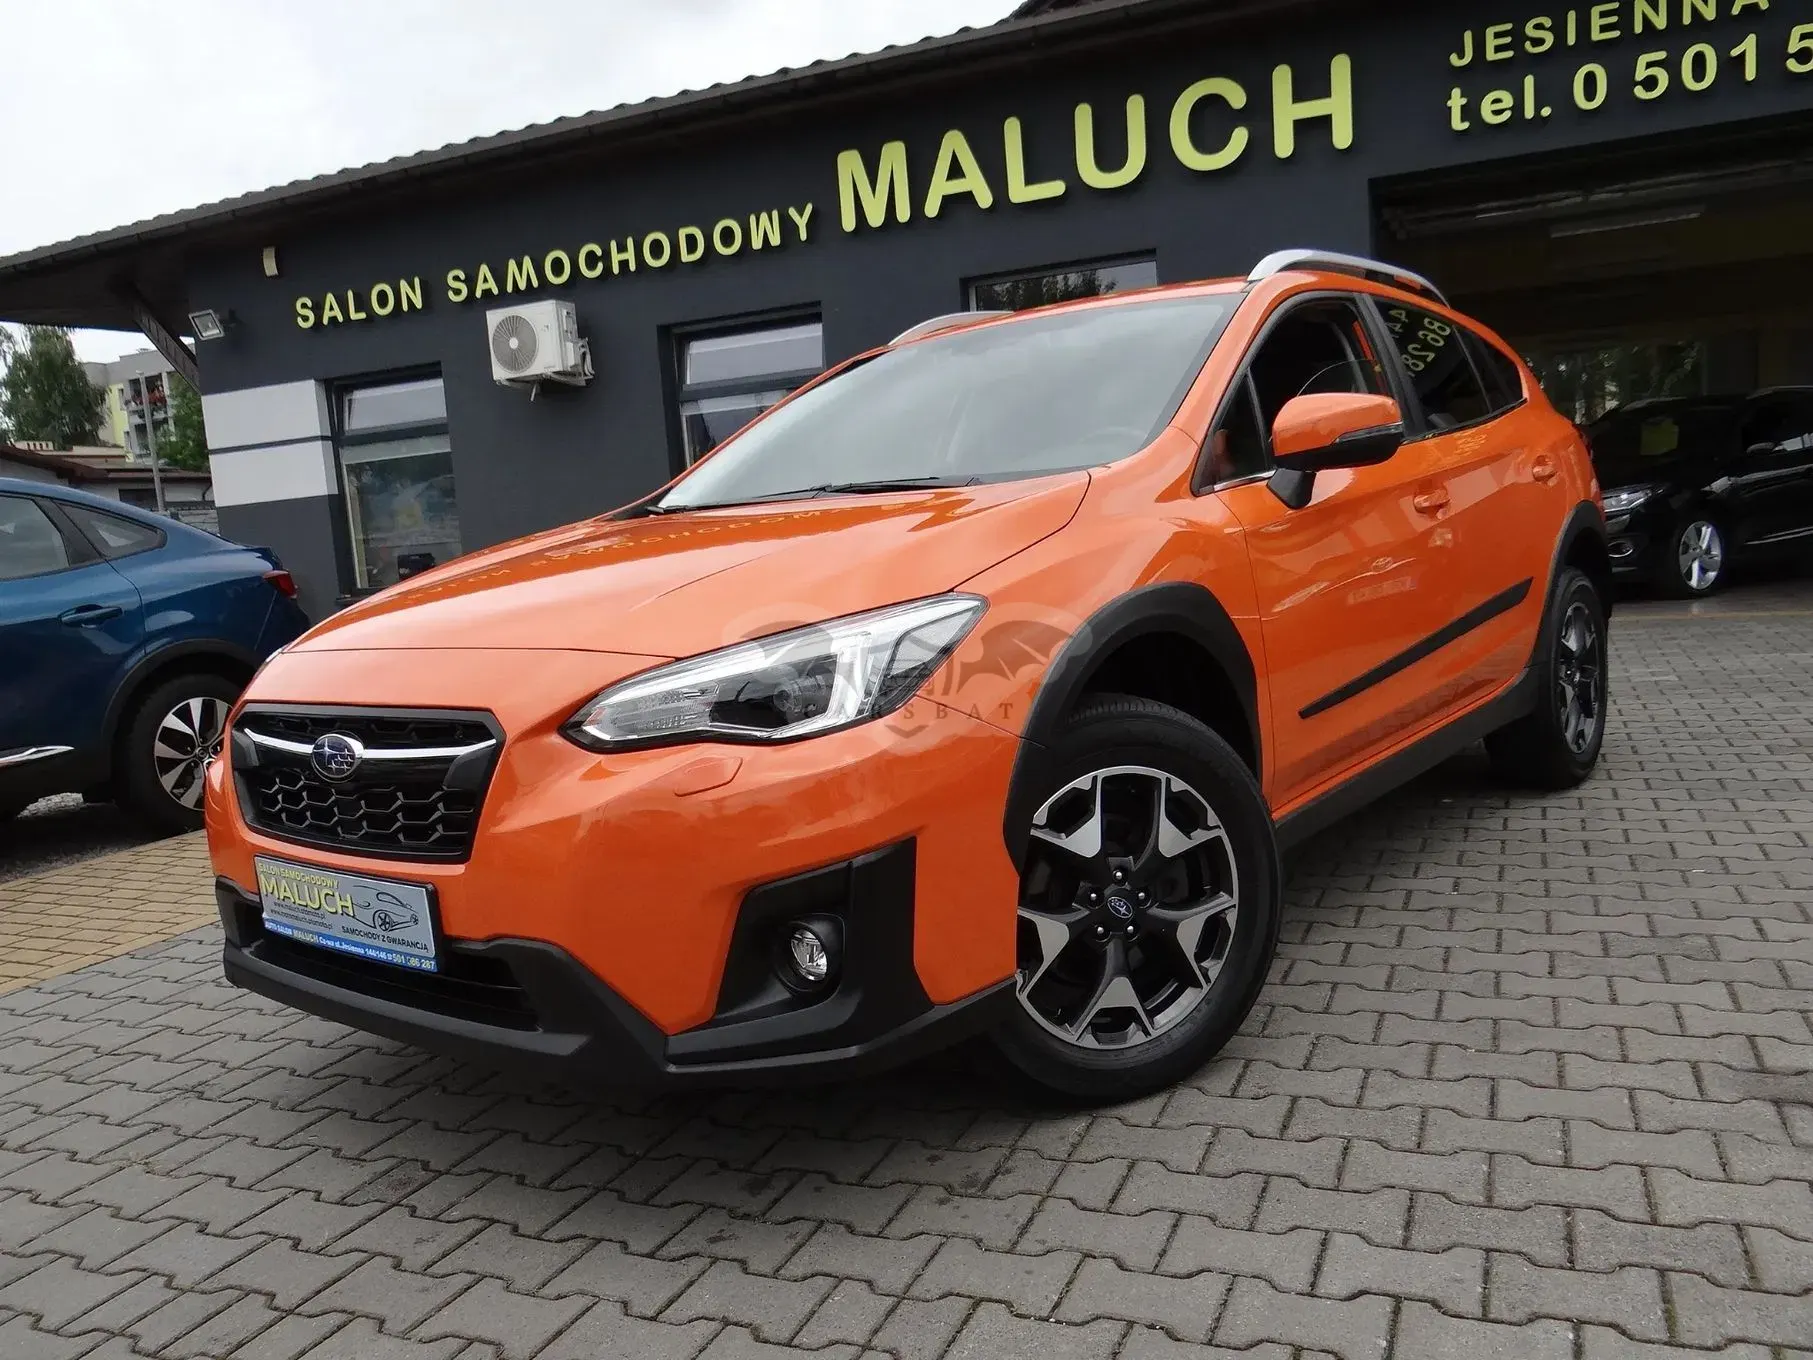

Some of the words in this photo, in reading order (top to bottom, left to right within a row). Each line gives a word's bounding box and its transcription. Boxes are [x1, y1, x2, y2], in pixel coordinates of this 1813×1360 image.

[1447, 74, 1552, 131] tel.
[1572, 63, 1608, 110] 0
[1633, 33, 1757, 99] 501
[296, 276, 423, 329] SALON
[446, 202, 813, 302] SAMOCHODOWY
[837, 53, 1354, 232] MALUCH
[258, 862, 280, 876] SALON
[280, 868, 339, 889] SAMOCHODOWY
[260, 874, 355, 917] MALUCH
[293, 929, 319, 943] MALUCH
[341, 926, 380, 941] SAMOCHODY
[381, 934, 386, 943] Z
[386, 936, 429, 953] GWARANCJĄ
